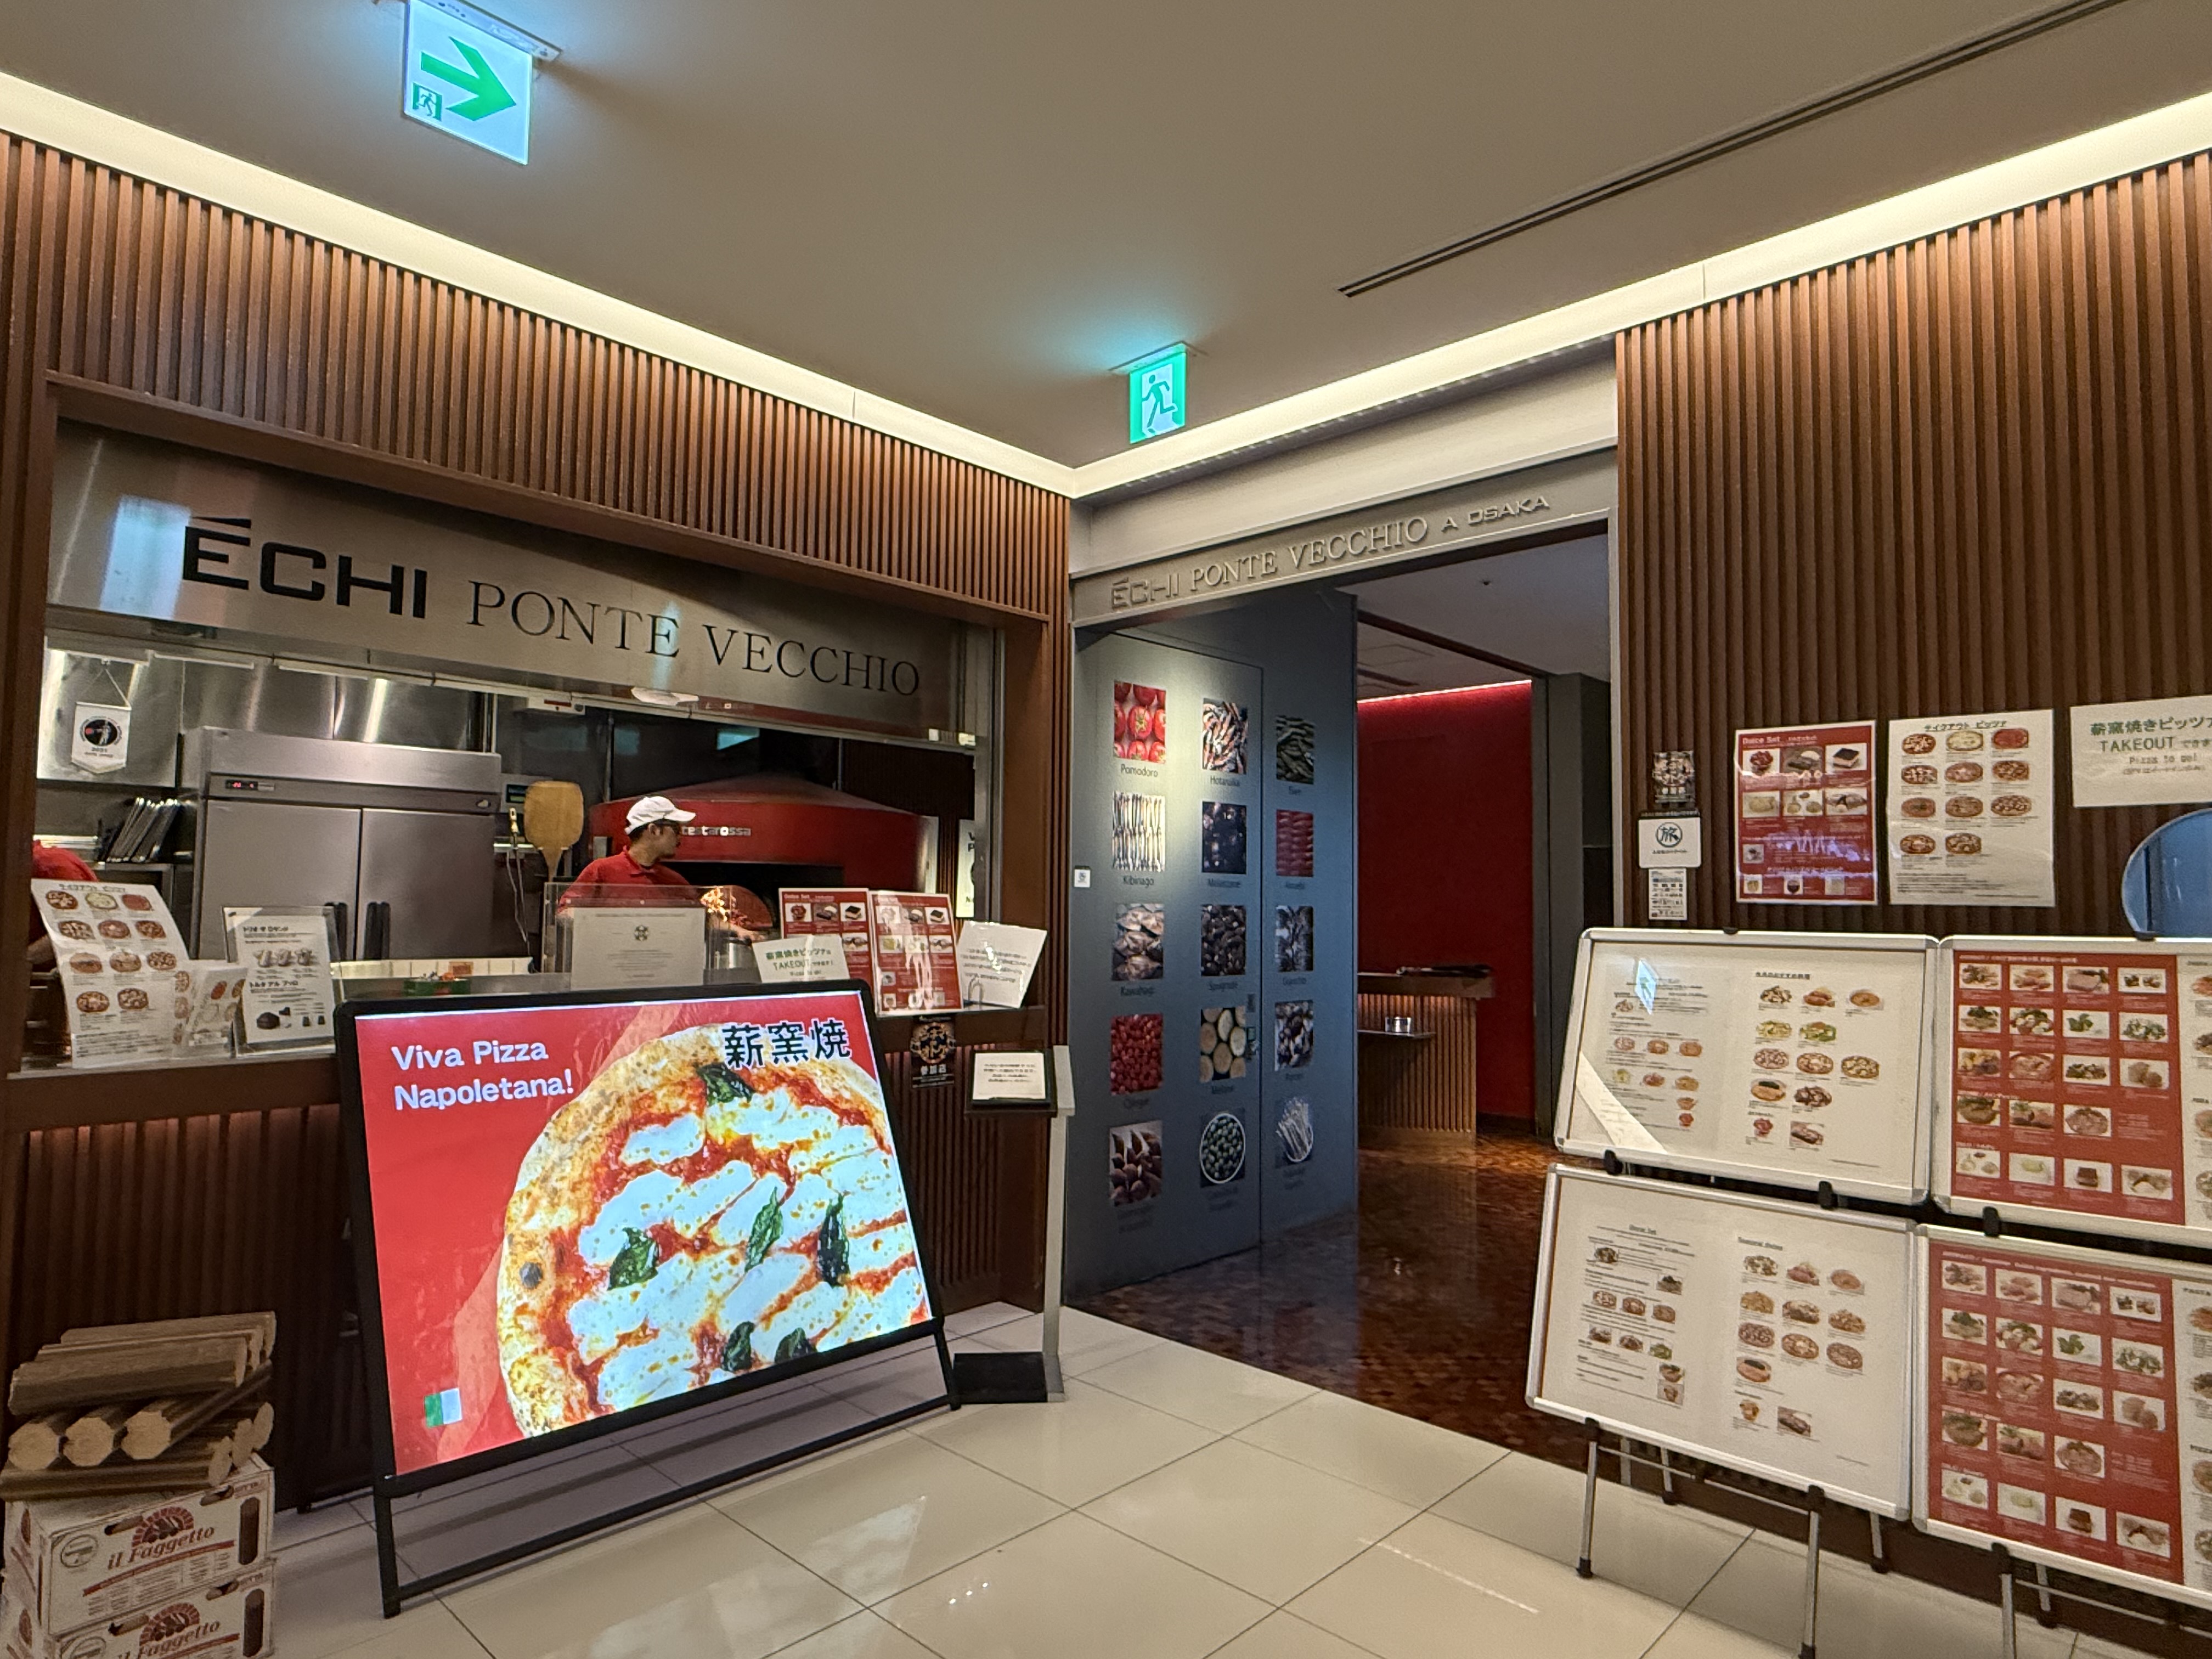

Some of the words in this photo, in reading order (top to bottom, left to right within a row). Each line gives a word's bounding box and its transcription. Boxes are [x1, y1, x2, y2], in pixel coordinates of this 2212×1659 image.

[1111, 573, 1180, 610] ÉCHI
[1190, 550, 1278, 591] PONTE
[1288, 517, 1427, 569] VECCHIO
[1441, 516, 1459, 532] A
[1468, 496, 1550, 526] OSAKA
[182, 517, 428, 619] ÉCHI
[466, 580, 680, 657] PONTE
[702, 624, 919, 696] VECCHIO
[2100, 736, 2175, 752] TAKEOUT
[1120, 764, 1159, 778] Pomodoro
[1123, 876, 1154, 888] Kibinago
[773, 960, 809, 970] TAKEOUT
[391, 1045, 465, 1070] Viva
[473, 1040, 549, 1065] Pizza
[722, 1019, 851, 1068] 薪窯焼
[394, 1068, 574, 1110] Napoletana!
[108, 1551, 123, 1570] il
[127, 1526, 215, 1564] Faggetto
